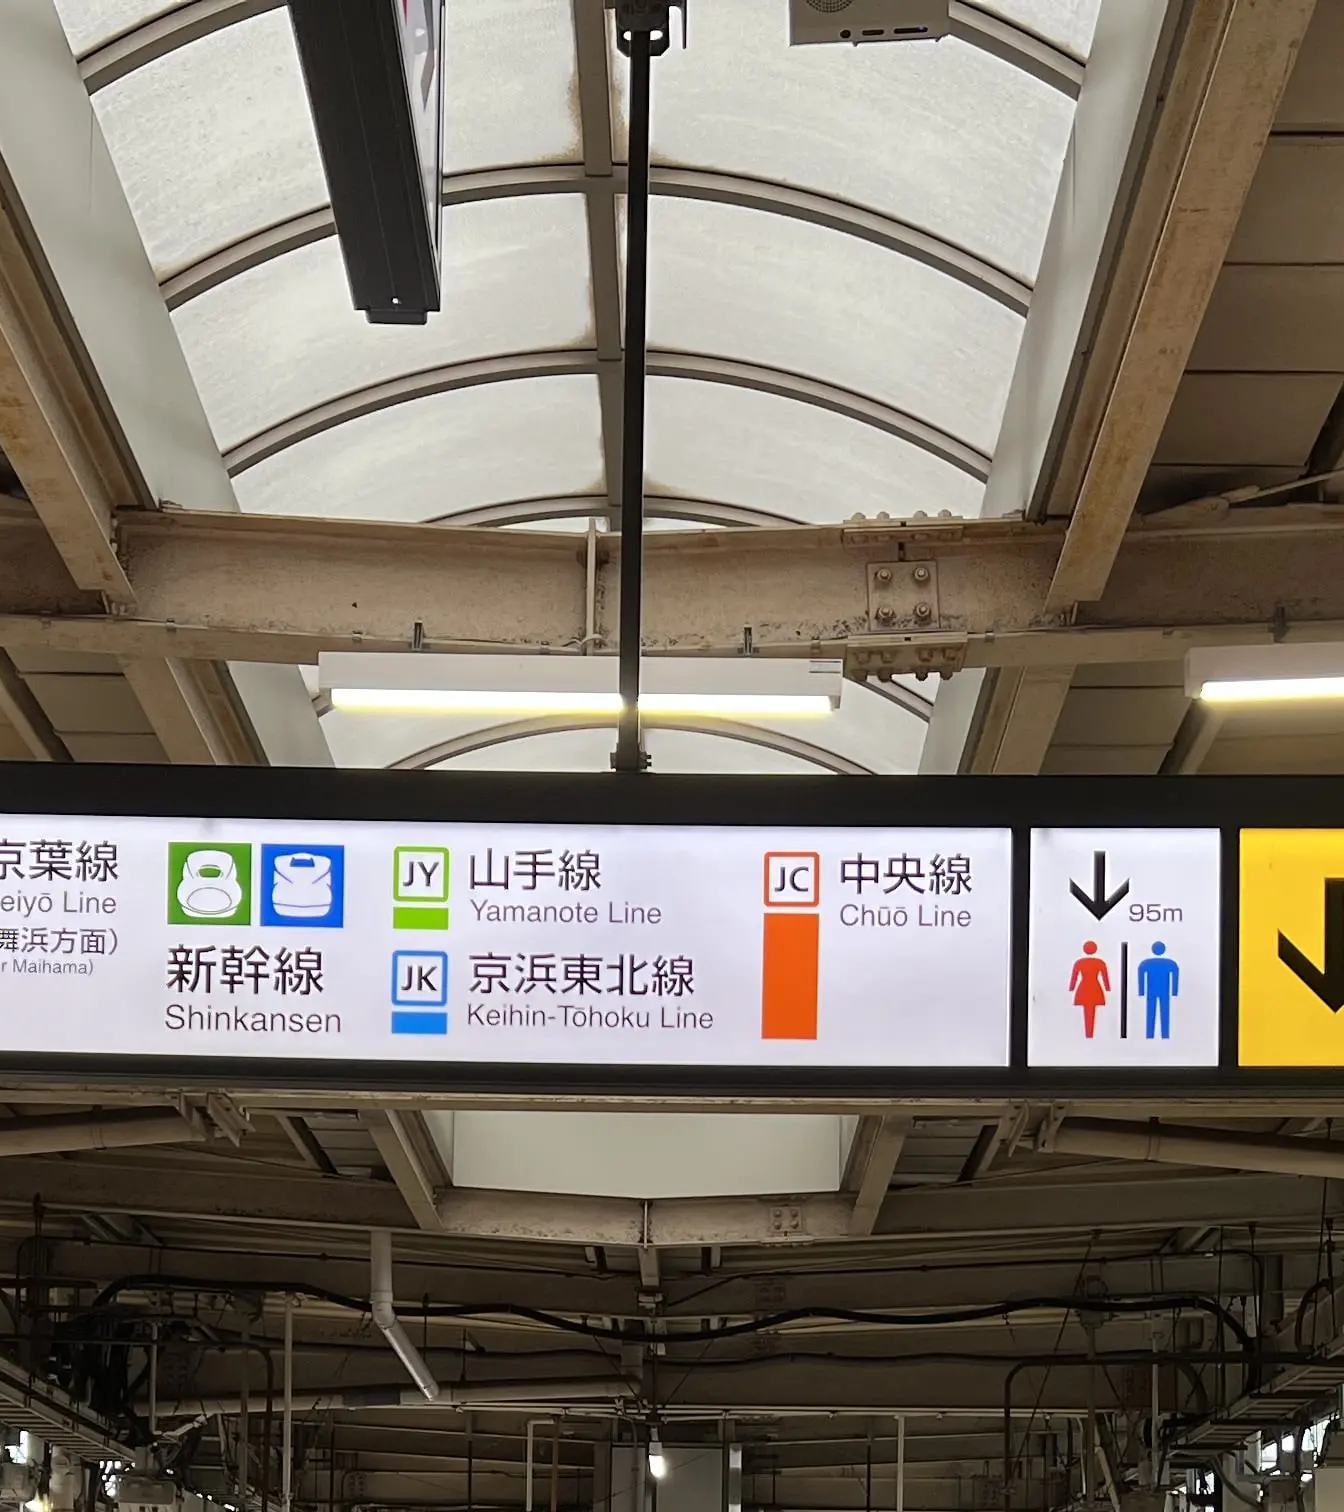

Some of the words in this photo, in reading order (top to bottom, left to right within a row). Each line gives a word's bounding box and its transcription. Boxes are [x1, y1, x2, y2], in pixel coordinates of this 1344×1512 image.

[402, 861, 439, 886] JY
[470, 847, 601, 892] 山手線
[773, 866, 810, 893] JC
[839, 852, 973, 897] 中央線
[62, 891, 117, 915] Line
[469, 899, 599, 925] Yamanote
[608, 901, 662, 925] Line
[839, 902, 907, 928] Chūō
[918, 904, 972, 928] Line
[1128, 903, 1184, 924] 95m
[11, 959, 94, 977] Maihama)
[167, 945, 324, 997] 新幹線
[401, 965, 439, 993] JK
[467, 952, 696, 997] 京浜東北線
[164, 1004, 342, 1035] Shinkansen
[467, 1003, 650, 1030] Keihin-Tōhoku
[659, 1007, 714, 1031] Line
